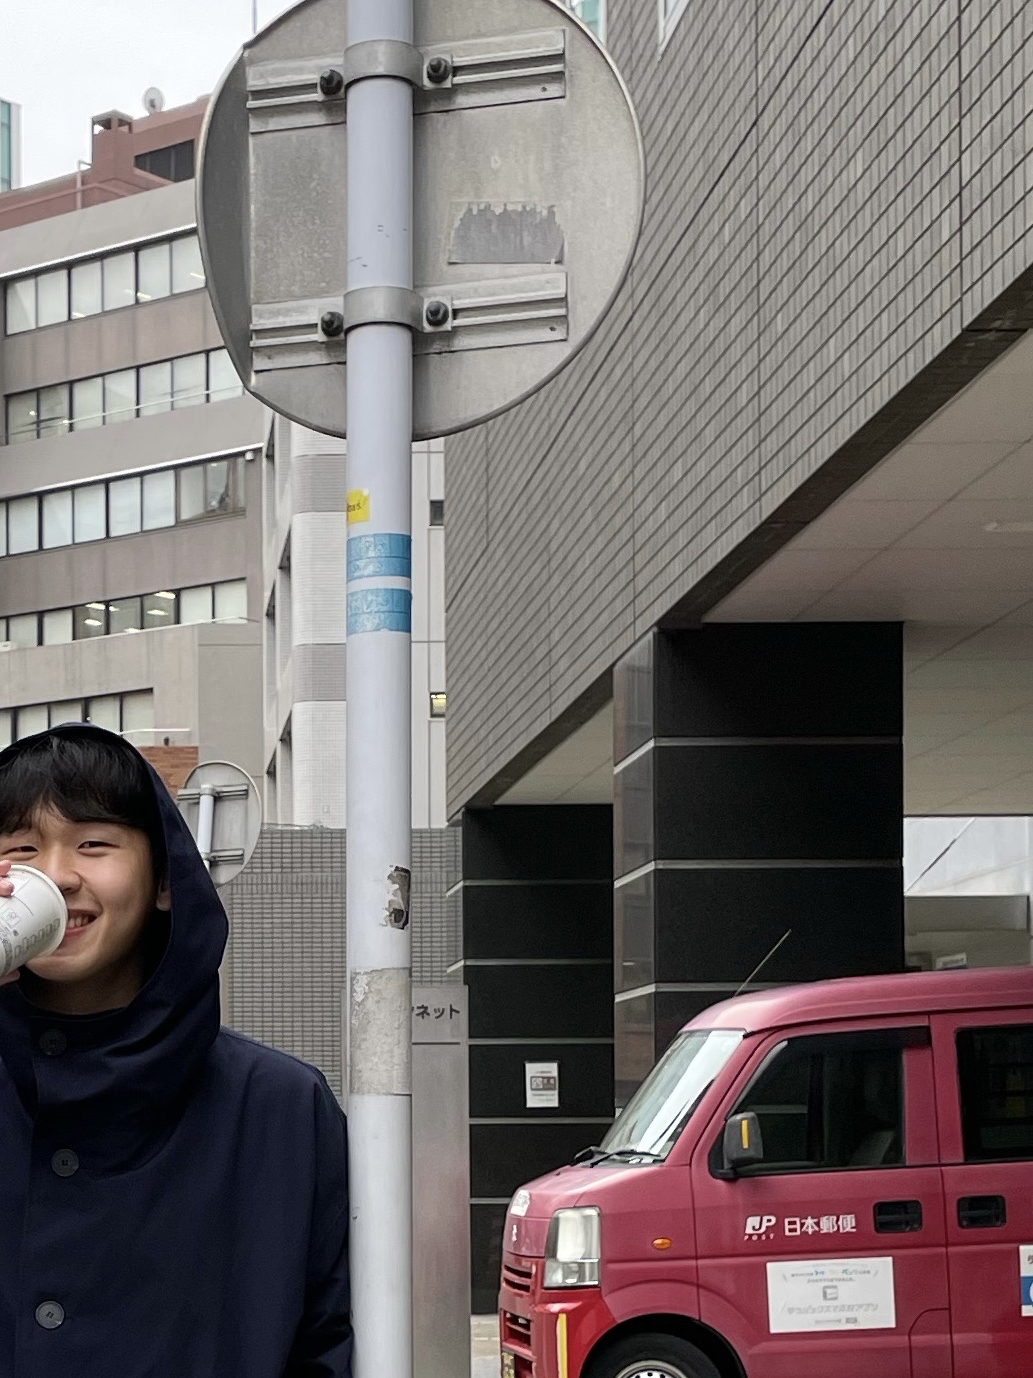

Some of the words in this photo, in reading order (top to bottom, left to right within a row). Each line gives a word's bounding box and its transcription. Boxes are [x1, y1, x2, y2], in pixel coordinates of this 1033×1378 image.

[411, 1003, 461, 1020] ネット
[745, 1215, 777, 1234] JP
[784, 1214, 857, 1236] 日本郵便
